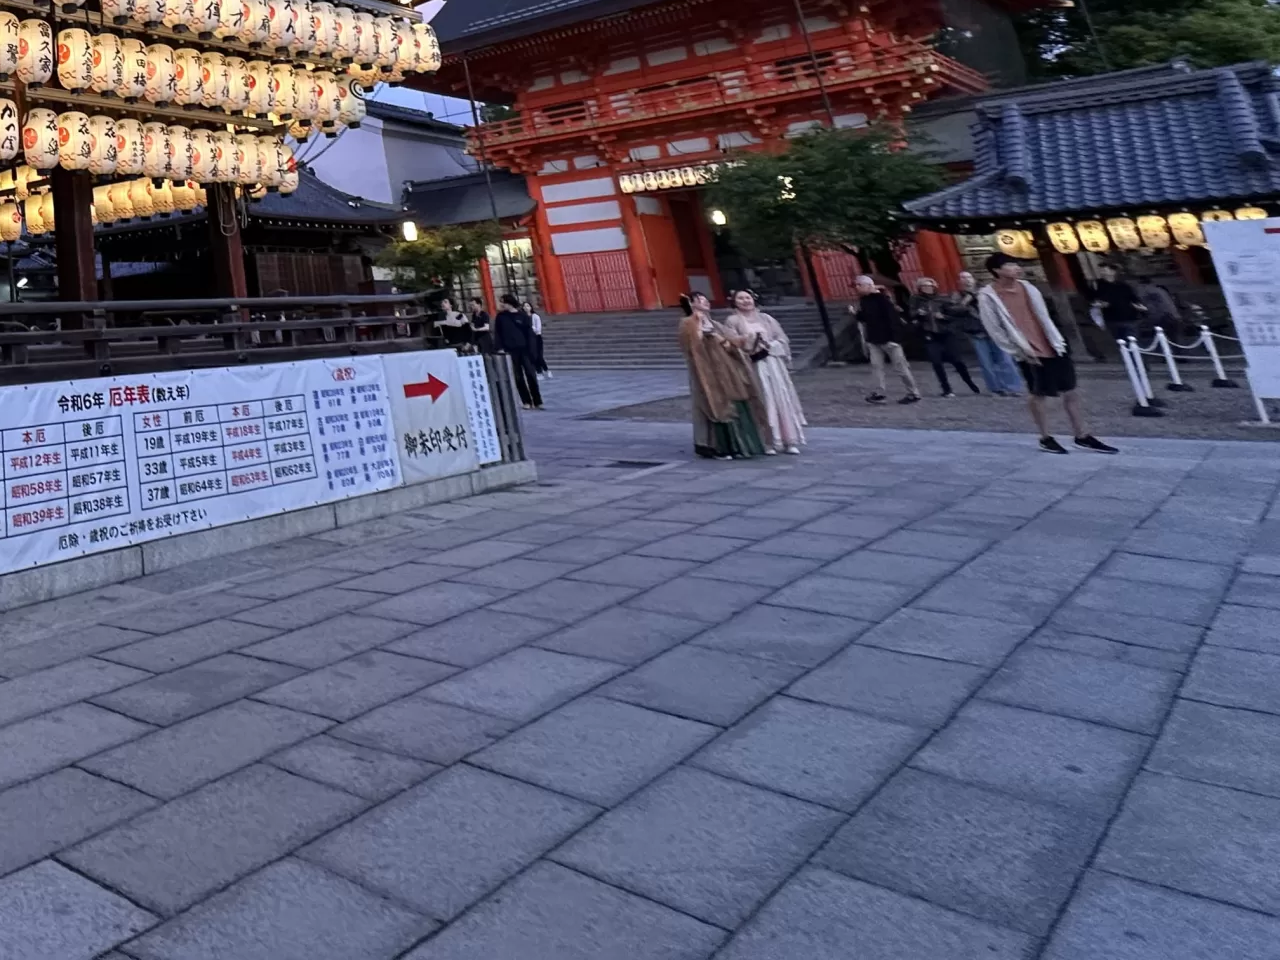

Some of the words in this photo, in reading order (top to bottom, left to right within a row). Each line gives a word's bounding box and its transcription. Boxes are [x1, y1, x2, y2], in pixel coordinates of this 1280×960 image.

[57, 392, 105, 414] 令和6年
[142, 413, 162, 428] 女性
[183, 409, 205, 423] 前厄
[231, 404, 250, 417] 本厄
[22, 429, 46, 445] 本厄
[82, 421, 105, 437] 後厄
[144, 436, 165, 451] 19歳
[174, 430, 218, 447] 平成19年生
[268, 417, 305, 432] 平成17年生
[404, 424, 468, 459] 御朱印受付
[10, 451, 62, 471] 平成12年生
[70, 442, 119, 462] 平成11年生
[144, 461, 168, 476] 33歳
[179, 455, 218, 470] 平成5年生
[231, 447, 263, 462] 平成4年生
[273, 440, 306, 455] 平成3年生
[11, 478, 63, 499] 昭和58年生
[72, 468, 121, 489] 昭和57年生
[147, 486, 170, 502] 37歳
[179, 478, 223, 497] 昭和64年生
[12, 506, 64, 528] 昭和39年生
[73, 495, 124, 515] 昭和38年生
